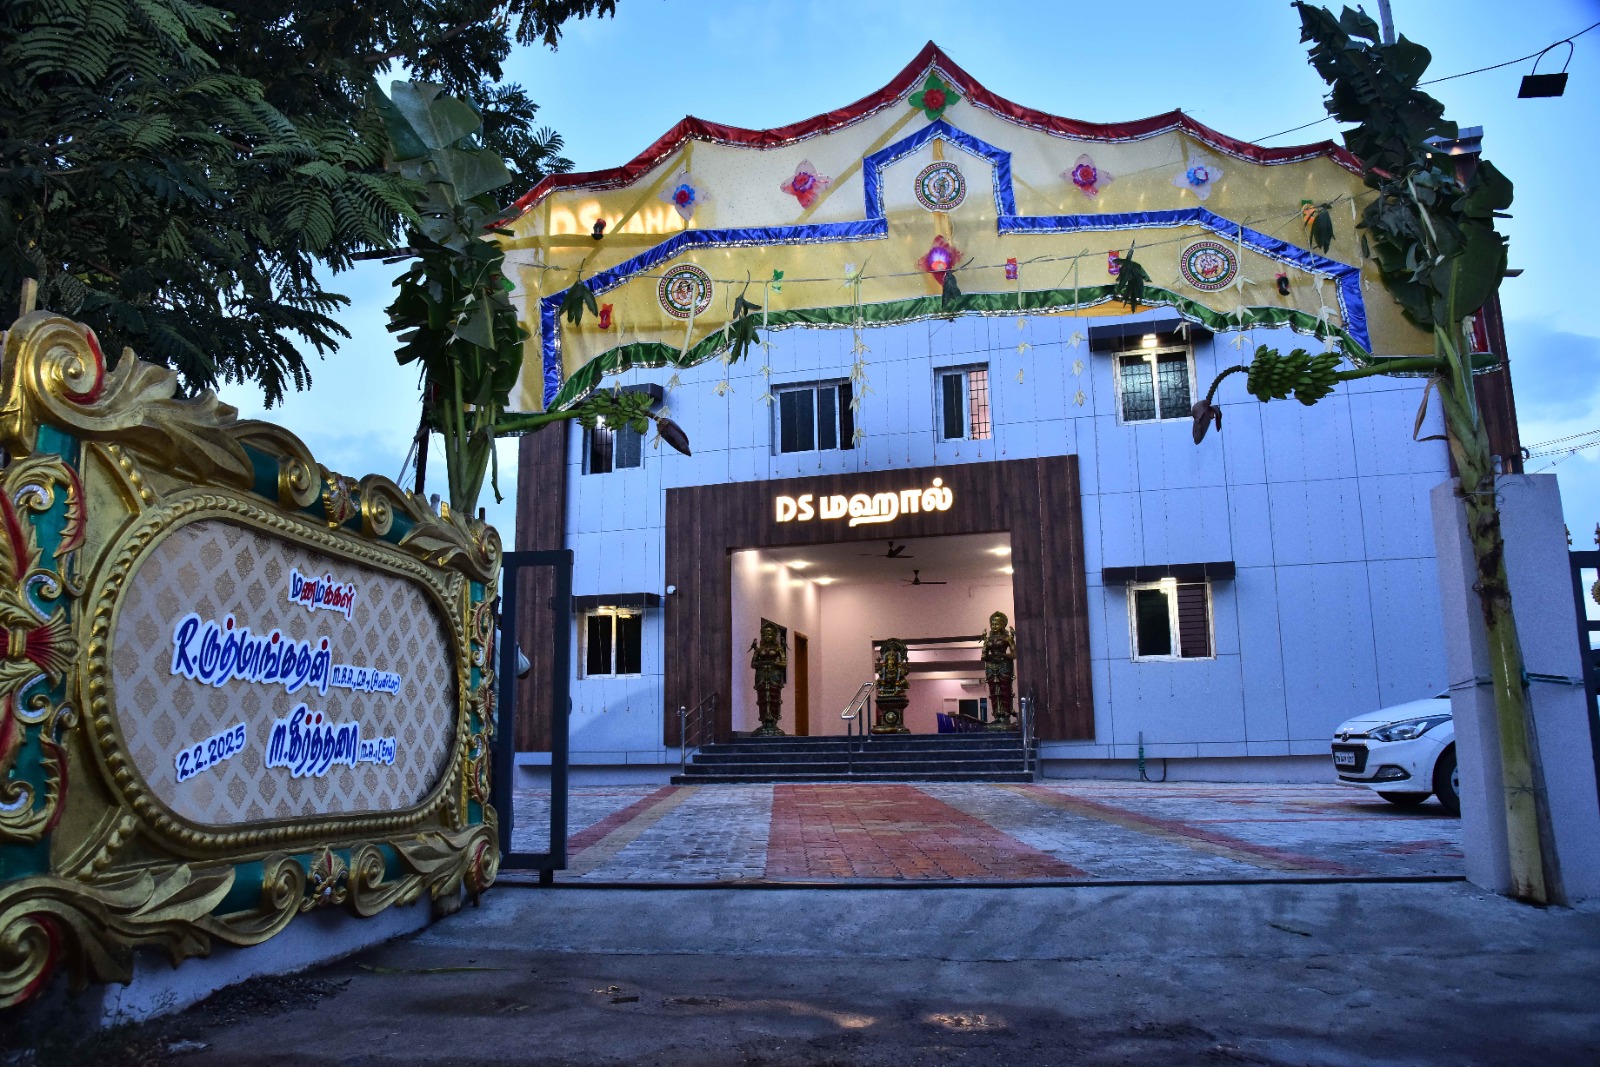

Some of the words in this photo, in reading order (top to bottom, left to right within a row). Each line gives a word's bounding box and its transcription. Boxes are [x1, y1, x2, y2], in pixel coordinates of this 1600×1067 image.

[776, 494, 815, 523] DS
[819, 477, 953, 528] மஹால்
[179, 725, 246, 780] 2.2.2025
